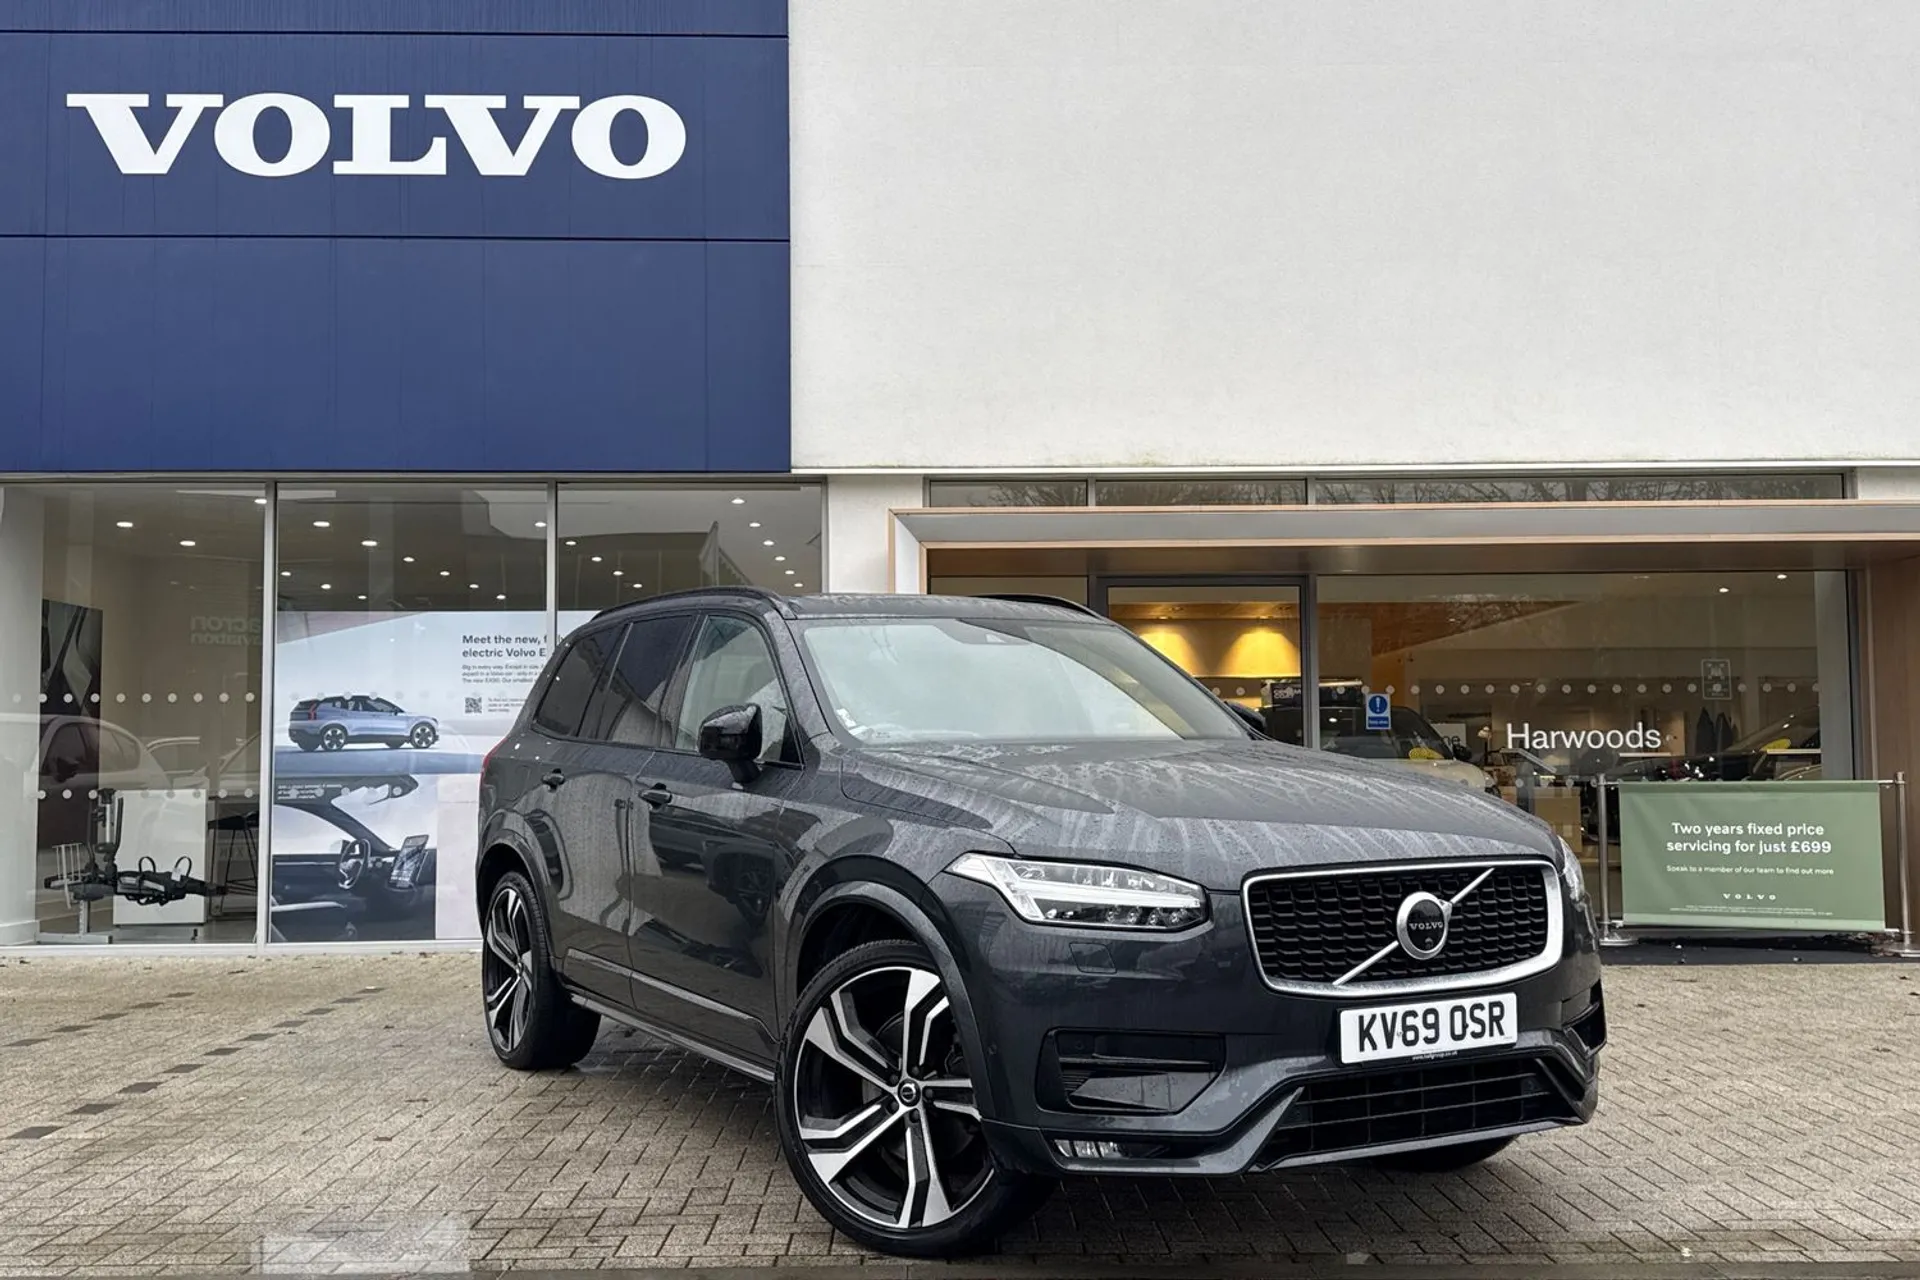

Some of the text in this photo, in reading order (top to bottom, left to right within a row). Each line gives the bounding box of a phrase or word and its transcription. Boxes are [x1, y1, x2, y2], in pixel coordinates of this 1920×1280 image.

[67, 92, 686, 179] VOLVO
[462, 635, 491, 644] Meet
[494, 635, 512, 644] the
[515, 636, 540, 646] new,
[462, 648, 503, 657] electric
[505, 648, 536, 657] Volvo
[1507, 722, 1661, 749] Harwoods
[1672, 822, 1824, 837] Two years fixed price
[1666, 840, 1832, 855] servicing for just £699
[1666, 865, 1688, 873] Speak
[1409, 921, 1444, 930] VOLVO
[1358, 1001, 1505, 1053] KV69 OSR
